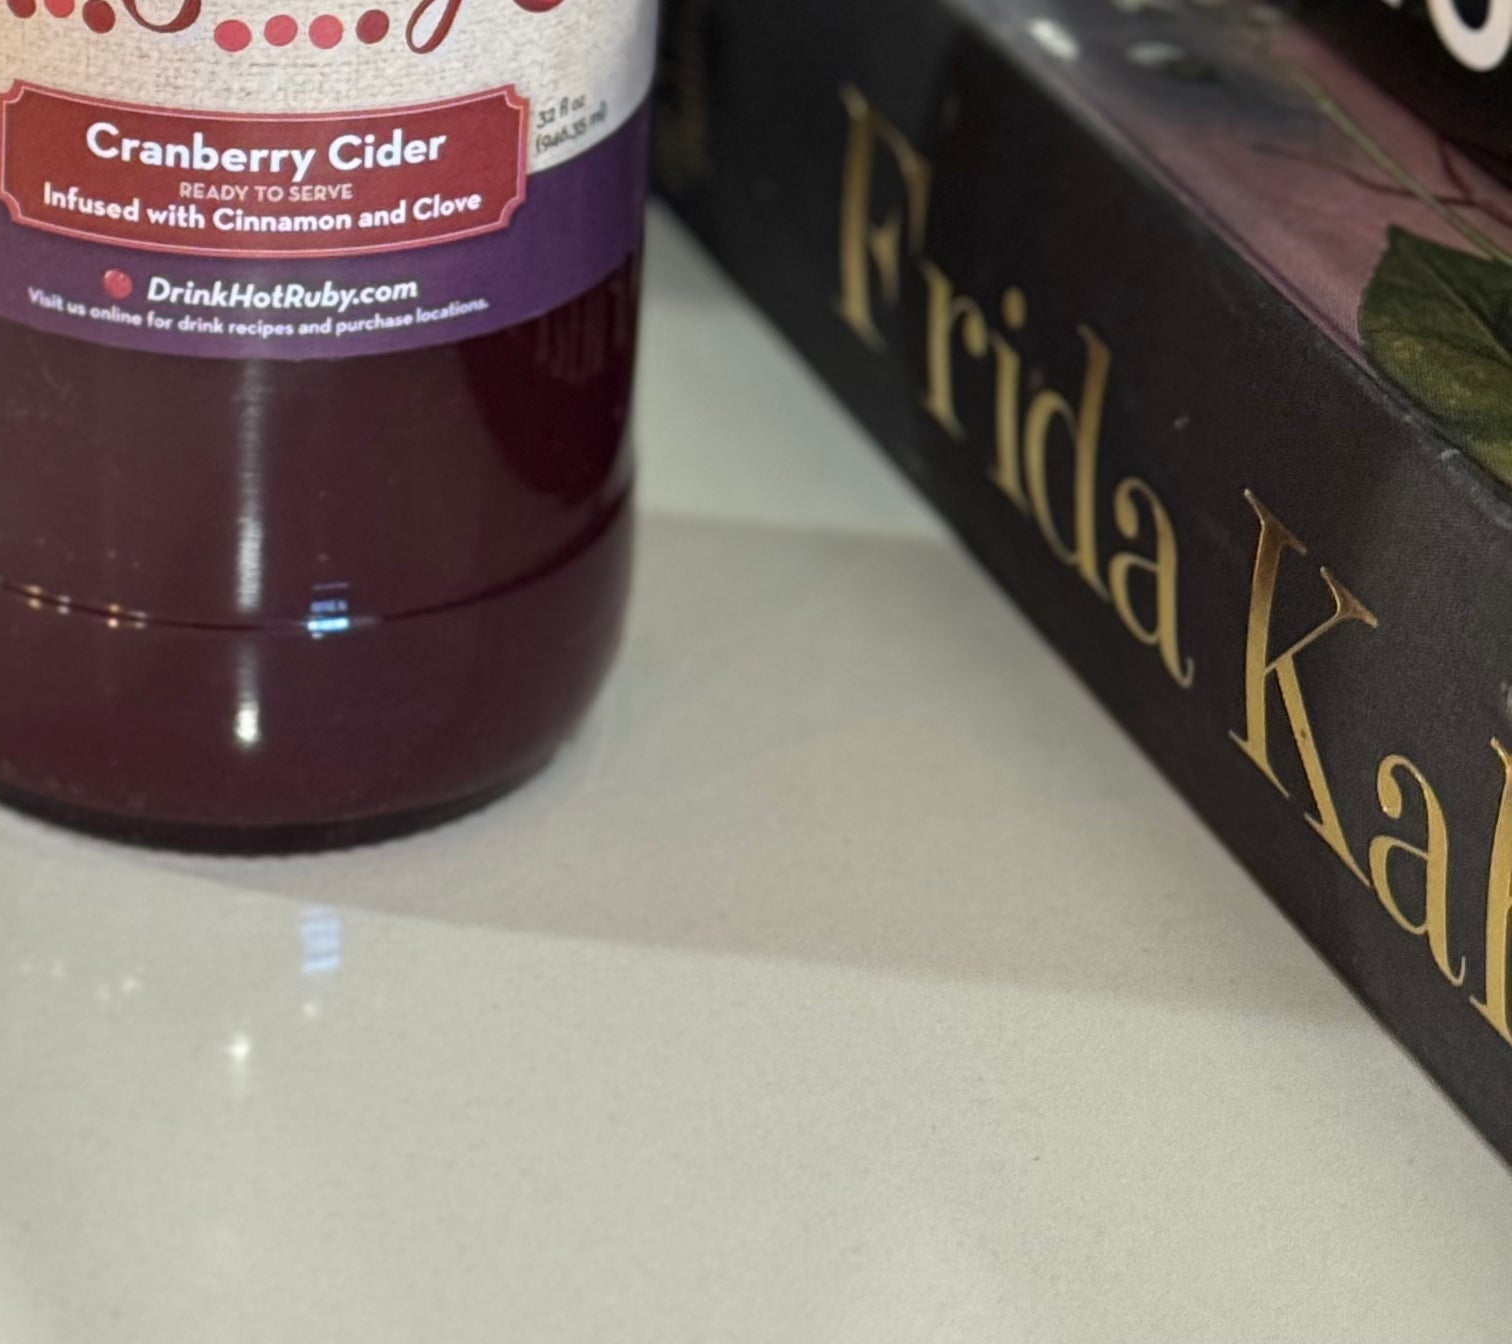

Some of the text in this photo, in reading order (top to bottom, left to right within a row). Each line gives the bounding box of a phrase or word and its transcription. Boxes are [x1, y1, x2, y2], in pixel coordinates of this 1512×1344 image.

[86, 122, 448, 181] Cranberry Cider
[43, 181, 483, 232] Infused with Cinnamon and Clove
[179, 181, 354, 202] READY TO SERVE
[28, 286, 489, 337] Visit us online for drink recipes and purchase locations.
[146, 276, 418, 312] DrinkHotRuby.com
[829, 82, 1194, 688] Frida
